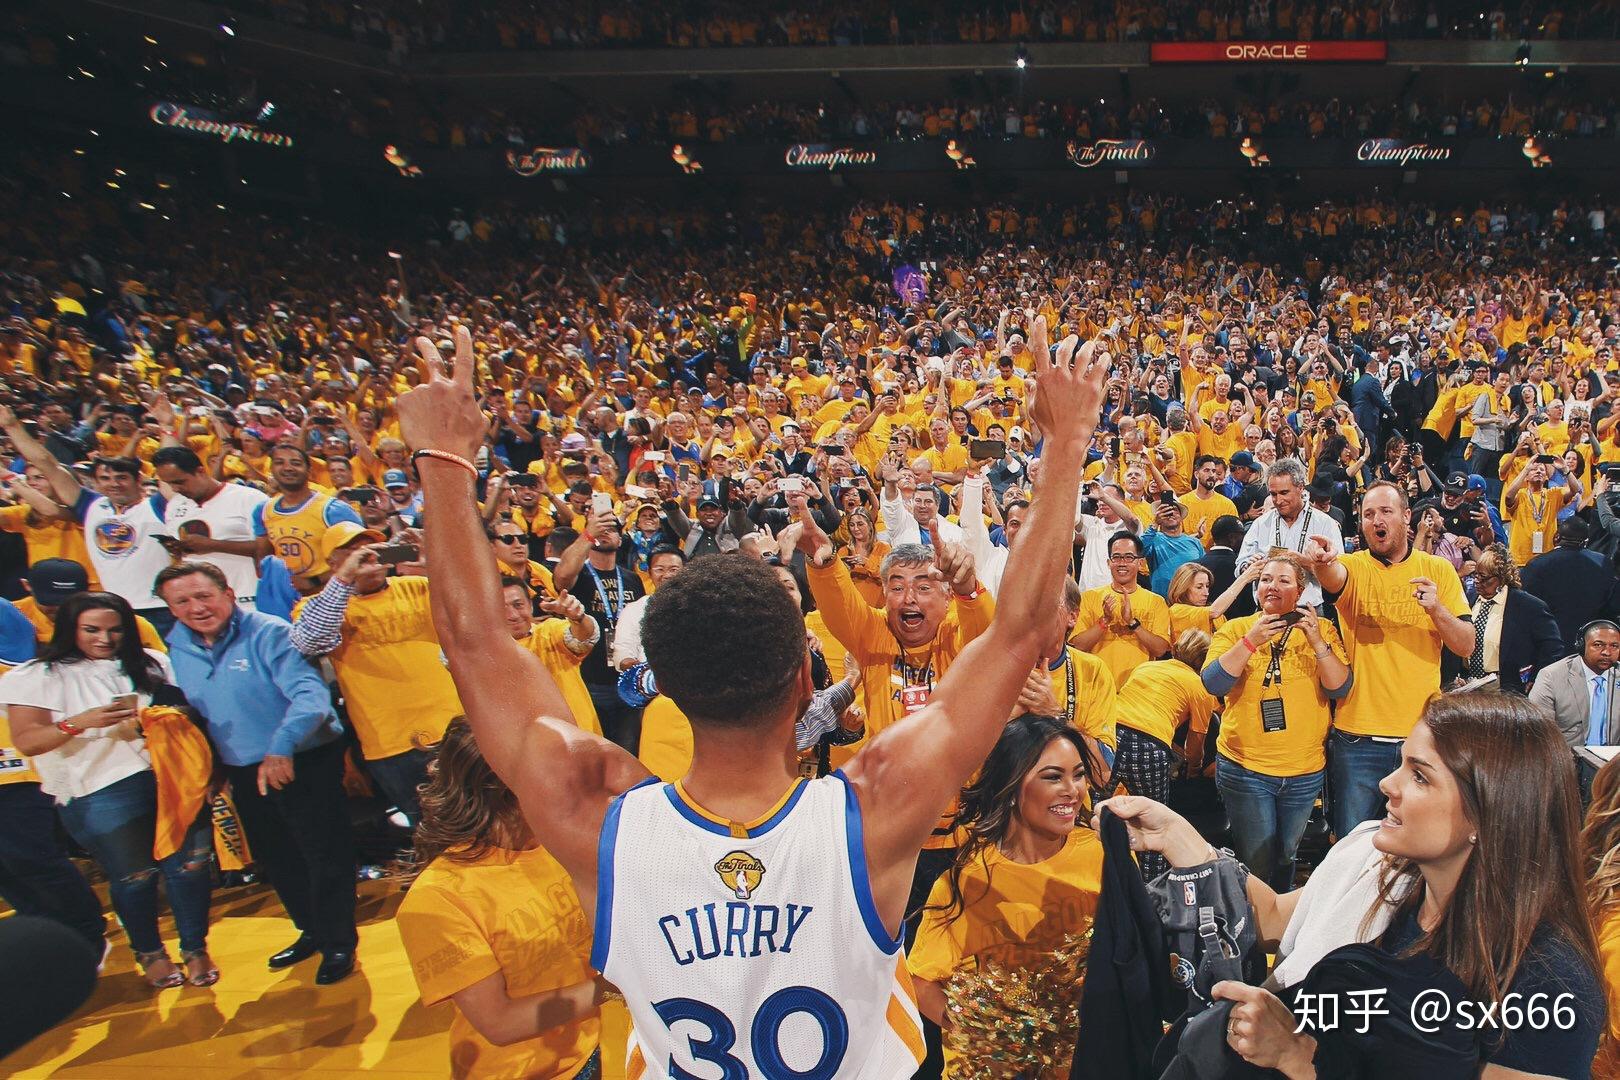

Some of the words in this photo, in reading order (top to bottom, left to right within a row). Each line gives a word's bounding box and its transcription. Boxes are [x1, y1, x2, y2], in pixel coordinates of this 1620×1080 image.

[1226, 44, 1307, 59] ORACLE
[150, 102, 293, 146] Champions
[785, 144, 876, 171] Champions
[1092, 139, 1148, 164] Finals
[1357, 140, 1450, 166] Champions
[278, 542, 301, 556] 30
[731, 857, 763, 872] Finals
[658, 901, 813, 966] CURRY
[650, 985, 849, 1080] 30
